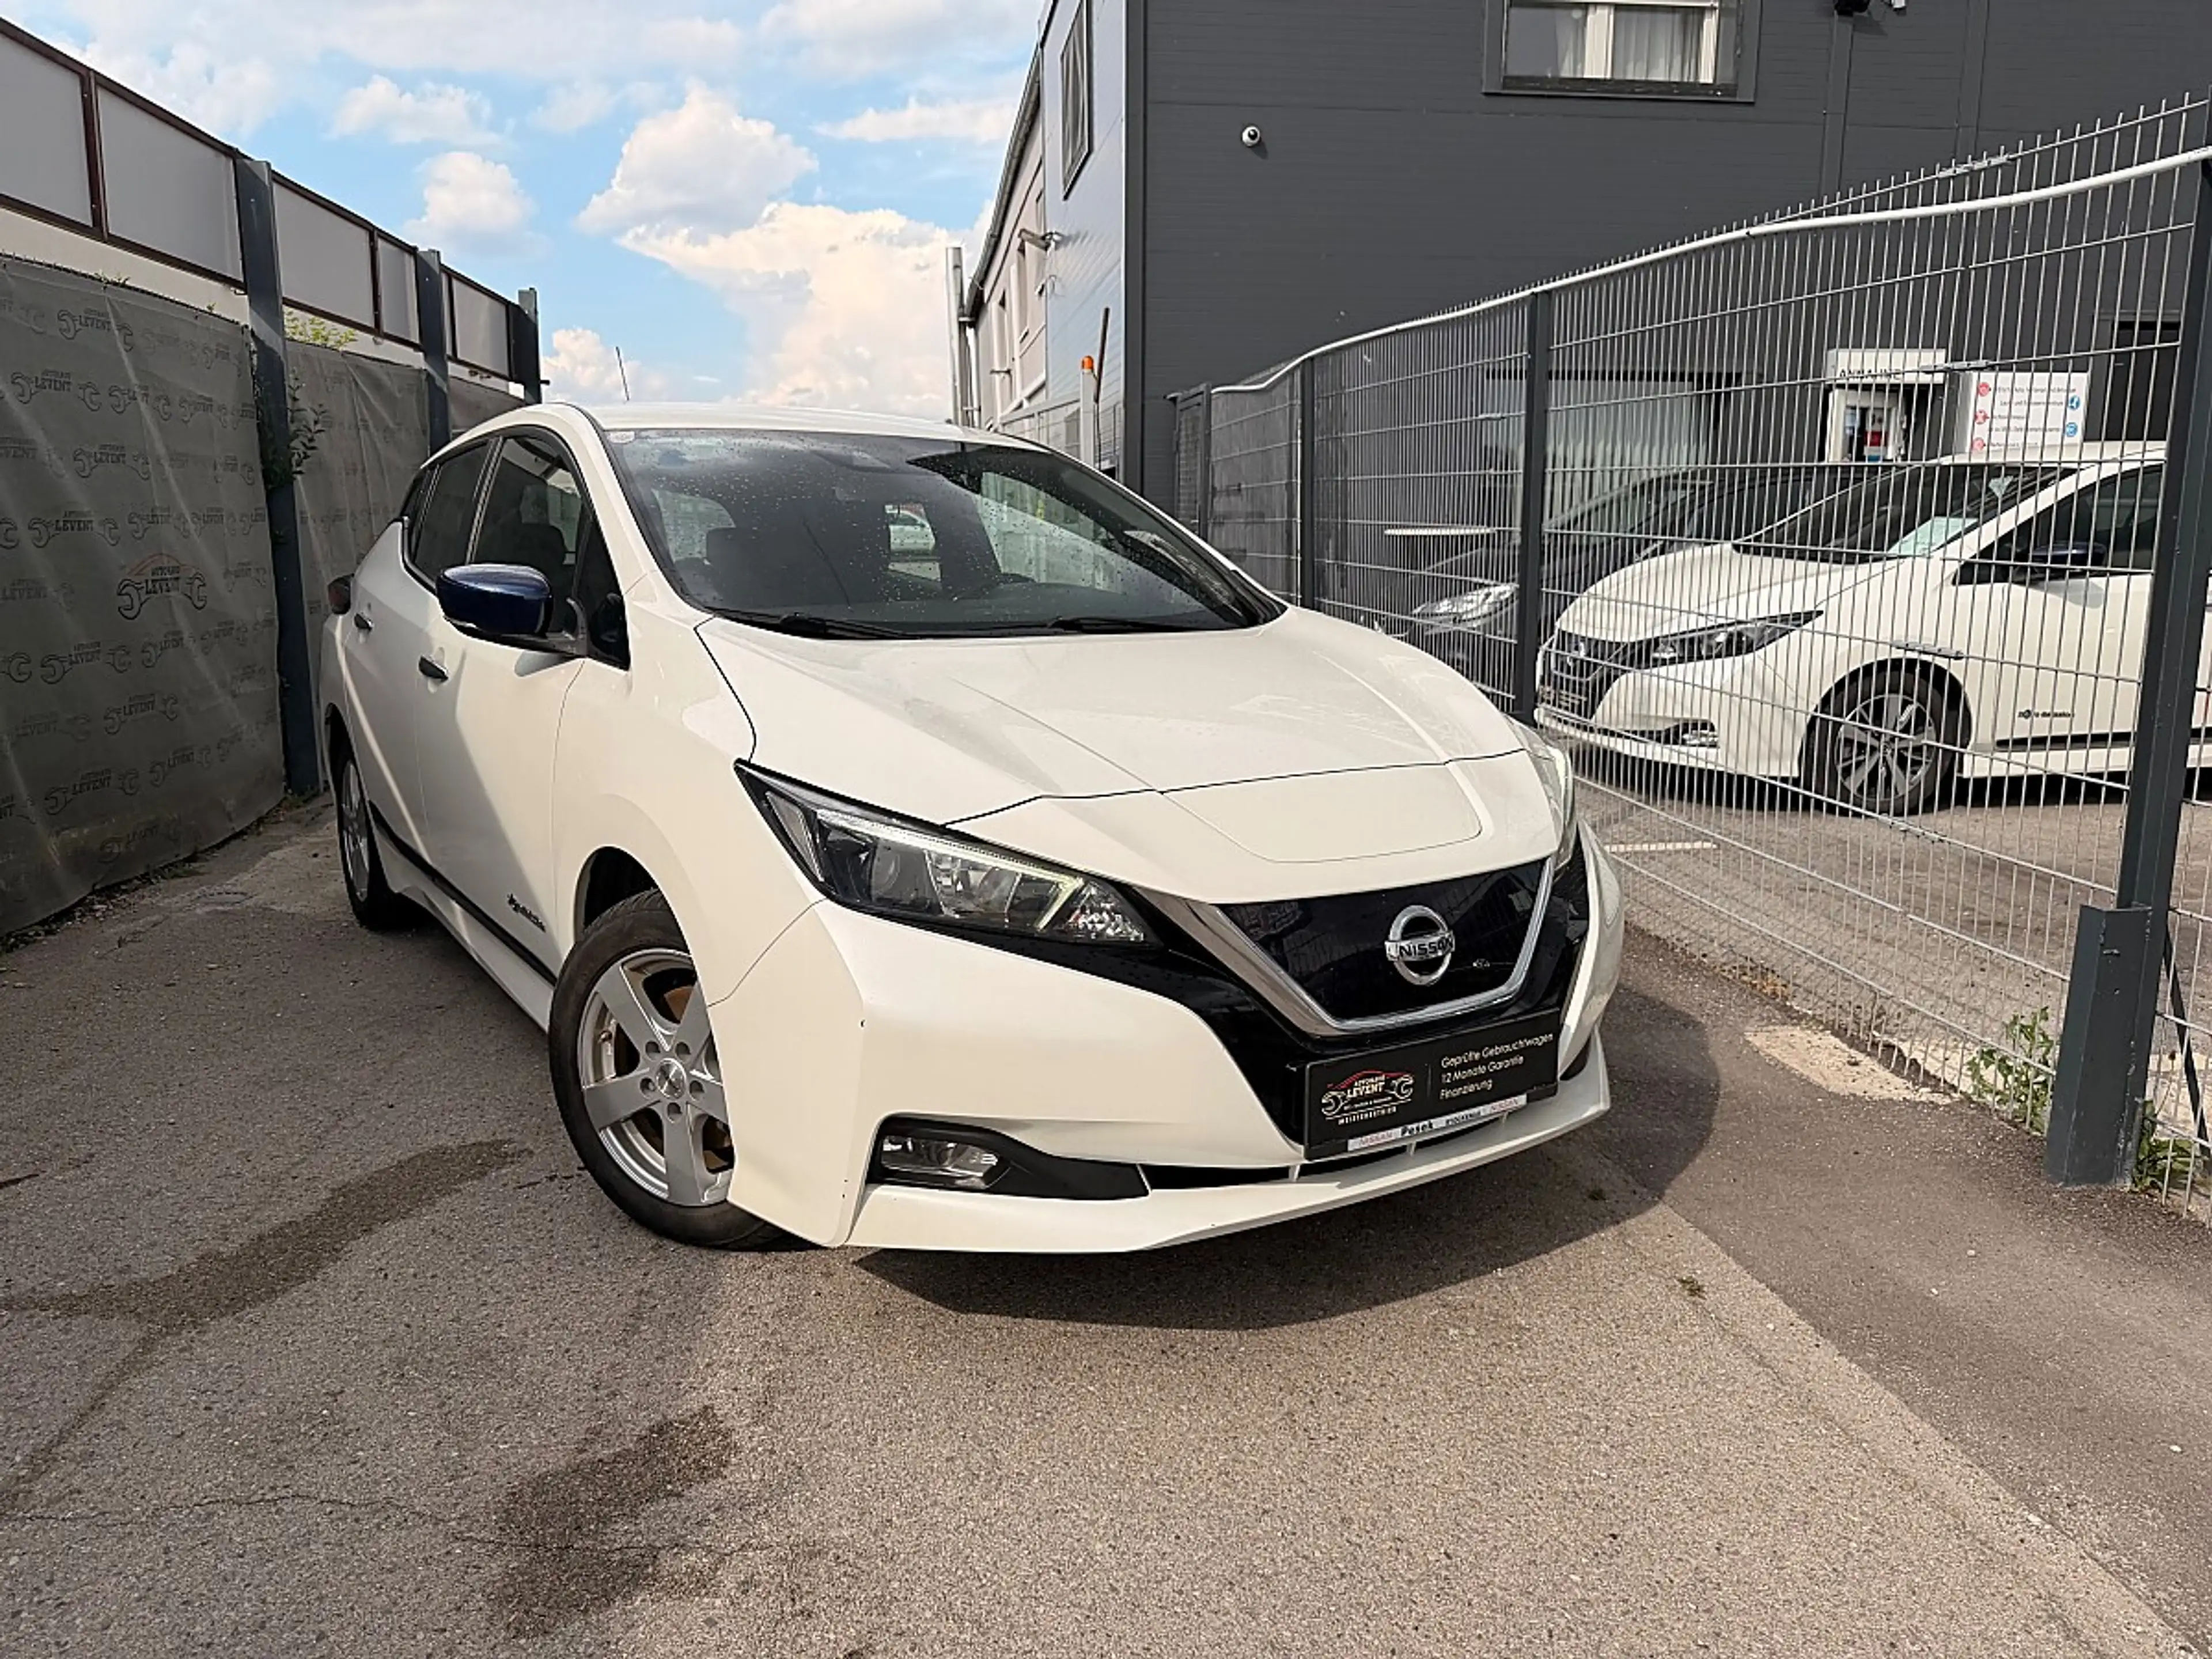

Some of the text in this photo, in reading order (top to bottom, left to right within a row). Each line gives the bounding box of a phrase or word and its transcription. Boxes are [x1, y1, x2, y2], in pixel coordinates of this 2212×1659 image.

[55, 518, 94, 532] LEVENT
[1399, 936, 1453, 957] NISSAN
[1441, 1054, 1524, 1084] 12 Monate Garantie
[1346, 1082, 1385, 1098] LEVENT
[1440, 1078, 1493, 1100] Finanzierung
